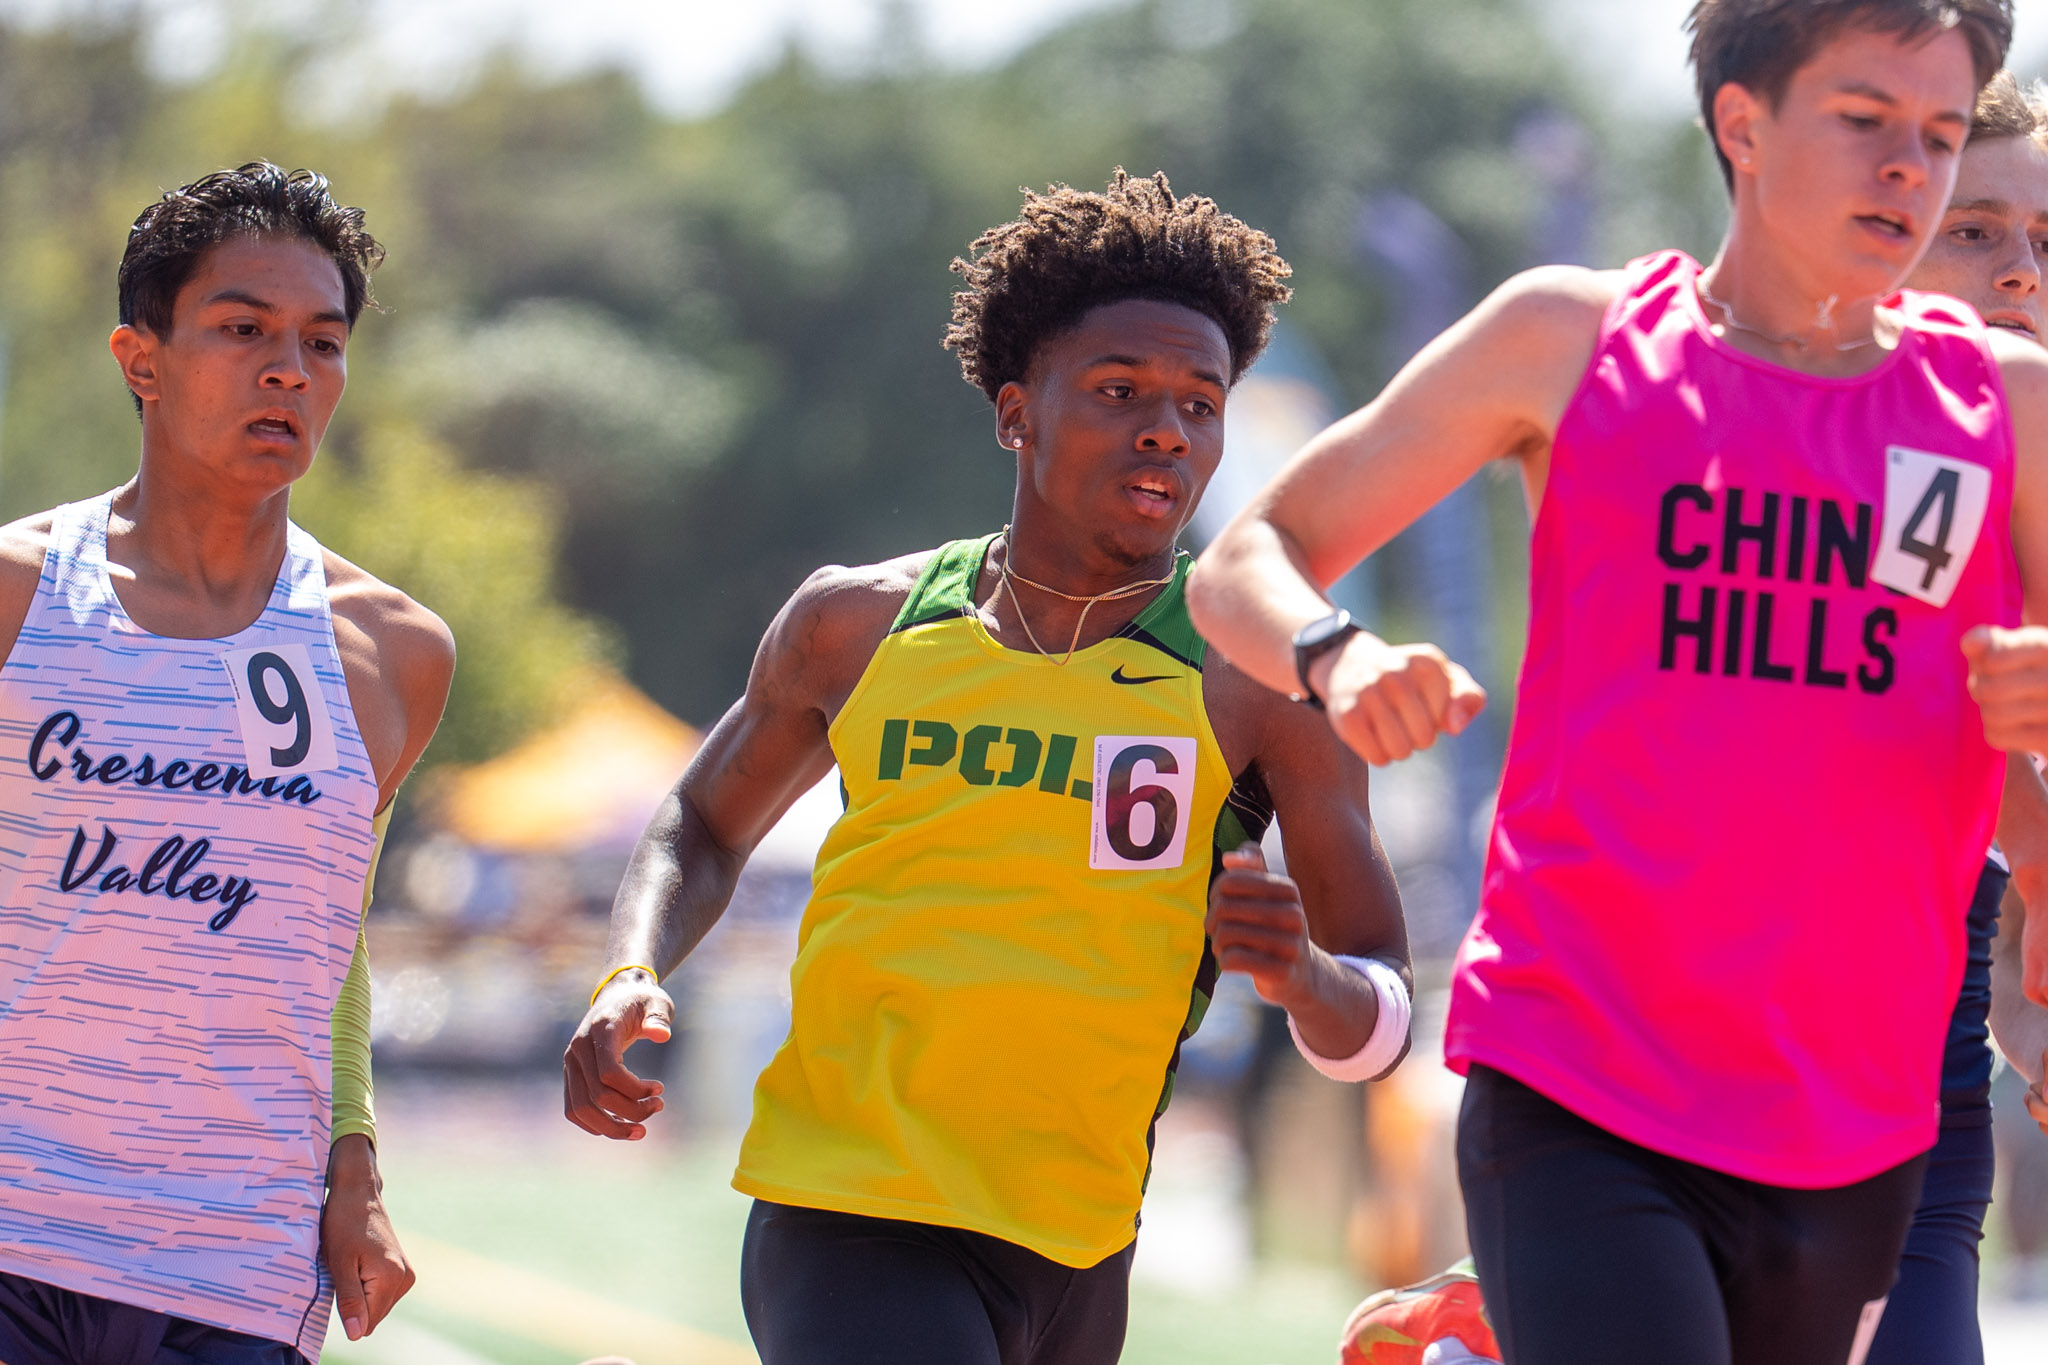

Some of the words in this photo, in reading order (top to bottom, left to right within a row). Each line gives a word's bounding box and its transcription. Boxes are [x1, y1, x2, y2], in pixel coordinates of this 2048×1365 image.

[1657, 483, 1908, 597] CHIN
[1898, 467, 1961, 590] 4
[1659, 583, 1898, 695] HILLS
[247, 651, 312, 768] 9
[877, 718, 1094, 803] POL
[1105, 744, 1179, 862] 6
[60, 824, 259, 932] Valley
